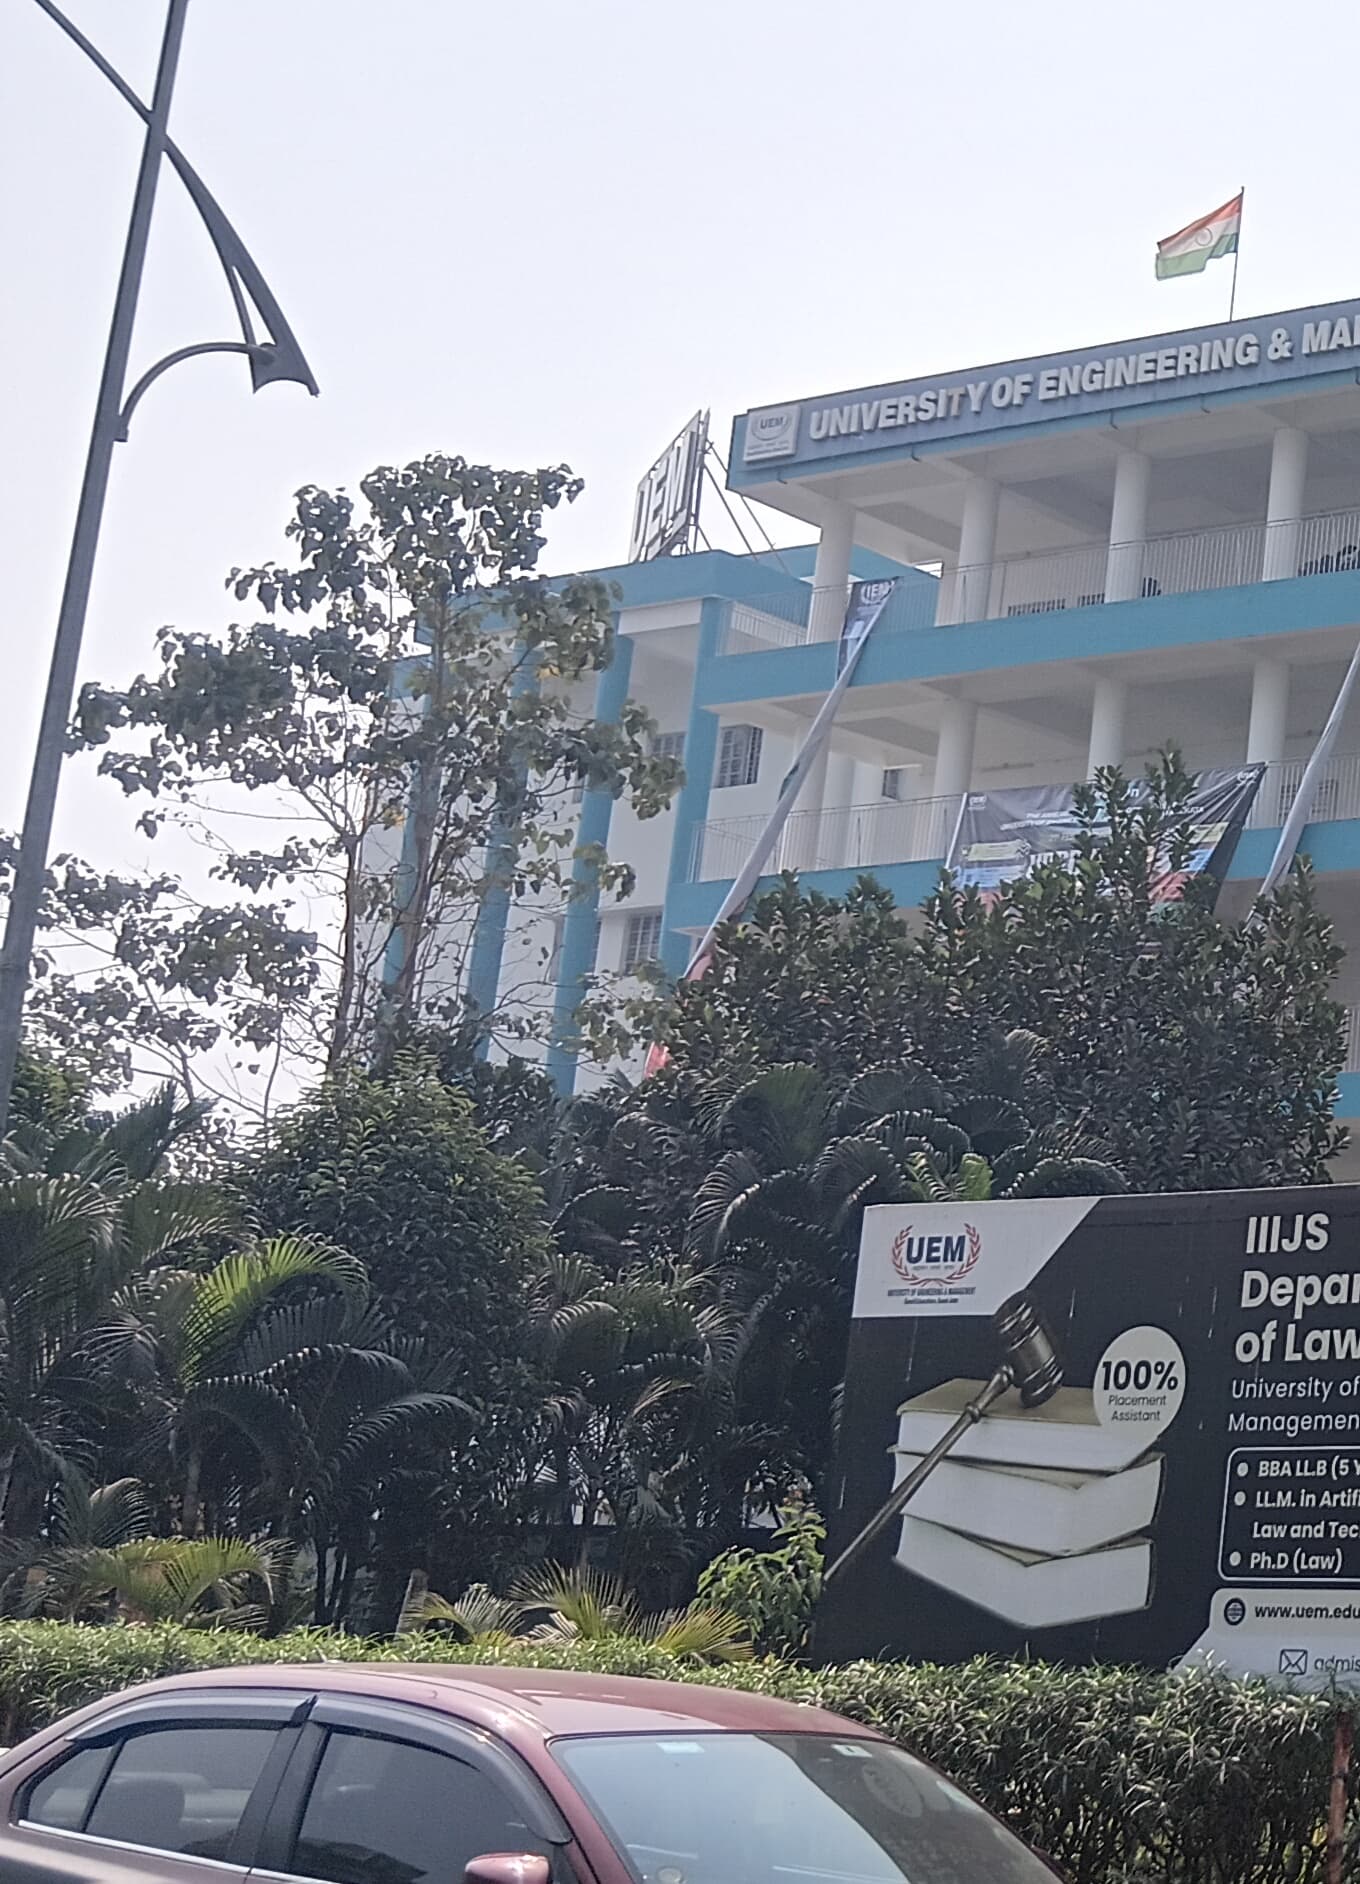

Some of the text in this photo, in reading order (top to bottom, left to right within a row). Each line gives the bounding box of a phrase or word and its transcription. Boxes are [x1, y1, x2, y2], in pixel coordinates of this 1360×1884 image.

[809, 381, 988, 440] UNIVERSITY
[991, 373, 1033, 409] OF
[1038, 333, 1259, 401] ENGINEERING
[1268, 328, 1292, 360] &
[1245, 1213, 1330, 1254] IIIJS
[906, 1235, 966, 1264] UEM
[1235, 1320, 1277, 1363] of
[1101, 1360, 1178, 1391] 100%
[1231, 1377, 1333, 1402] University
[1339, 1375, 1360, 1397] of
[1108, 1393, 1167, 1406] Placement
[1111, 1408, 1160, 1422] Assistant
[1258, 1460, 1292, 1478] BBA
[1331, 1455, 1349, 1480] (5
[1255, 1490, 1297, 1508] LL.M.
[1300, 1489, 1316, 1508] in
[1252, 1521, 1287, 1538] Law
[1289, 1520, 1324, 1538] and
[1250, 1547, 1343, 1573] Ph.D (Law)
